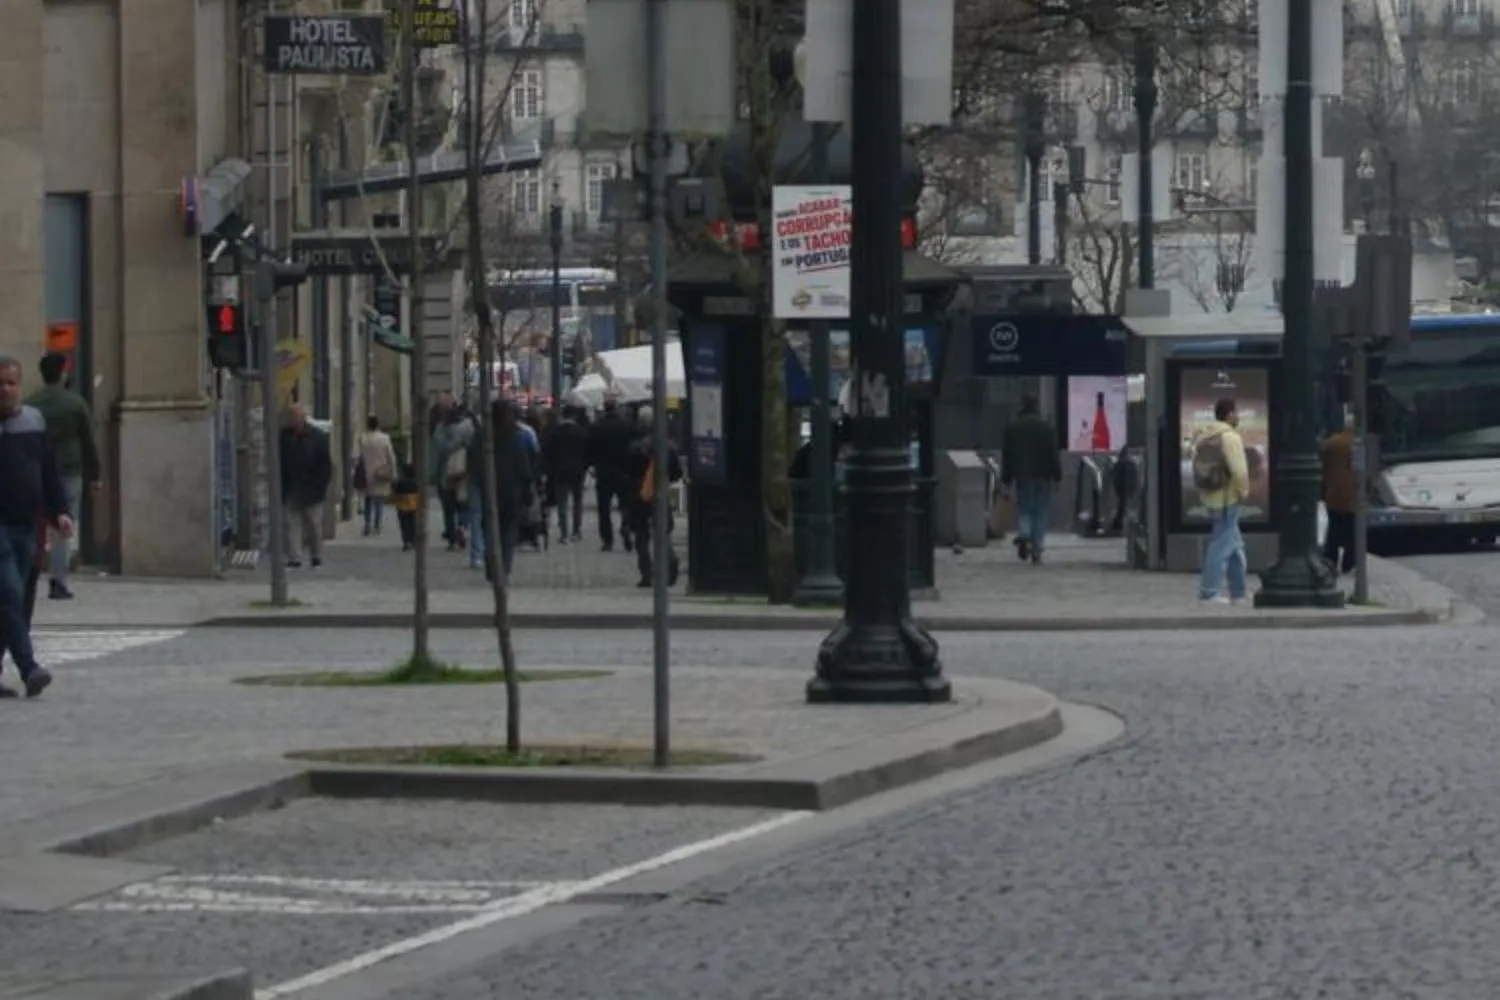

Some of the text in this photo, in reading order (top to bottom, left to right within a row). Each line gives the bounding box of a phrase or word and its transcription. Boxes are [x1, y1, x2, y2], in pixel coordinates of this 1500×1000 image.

[289, 18, 357, 43] HOTEL
[805, 231, 852, 250] TACHO
[298, 249, 355, 265] HOTEL
